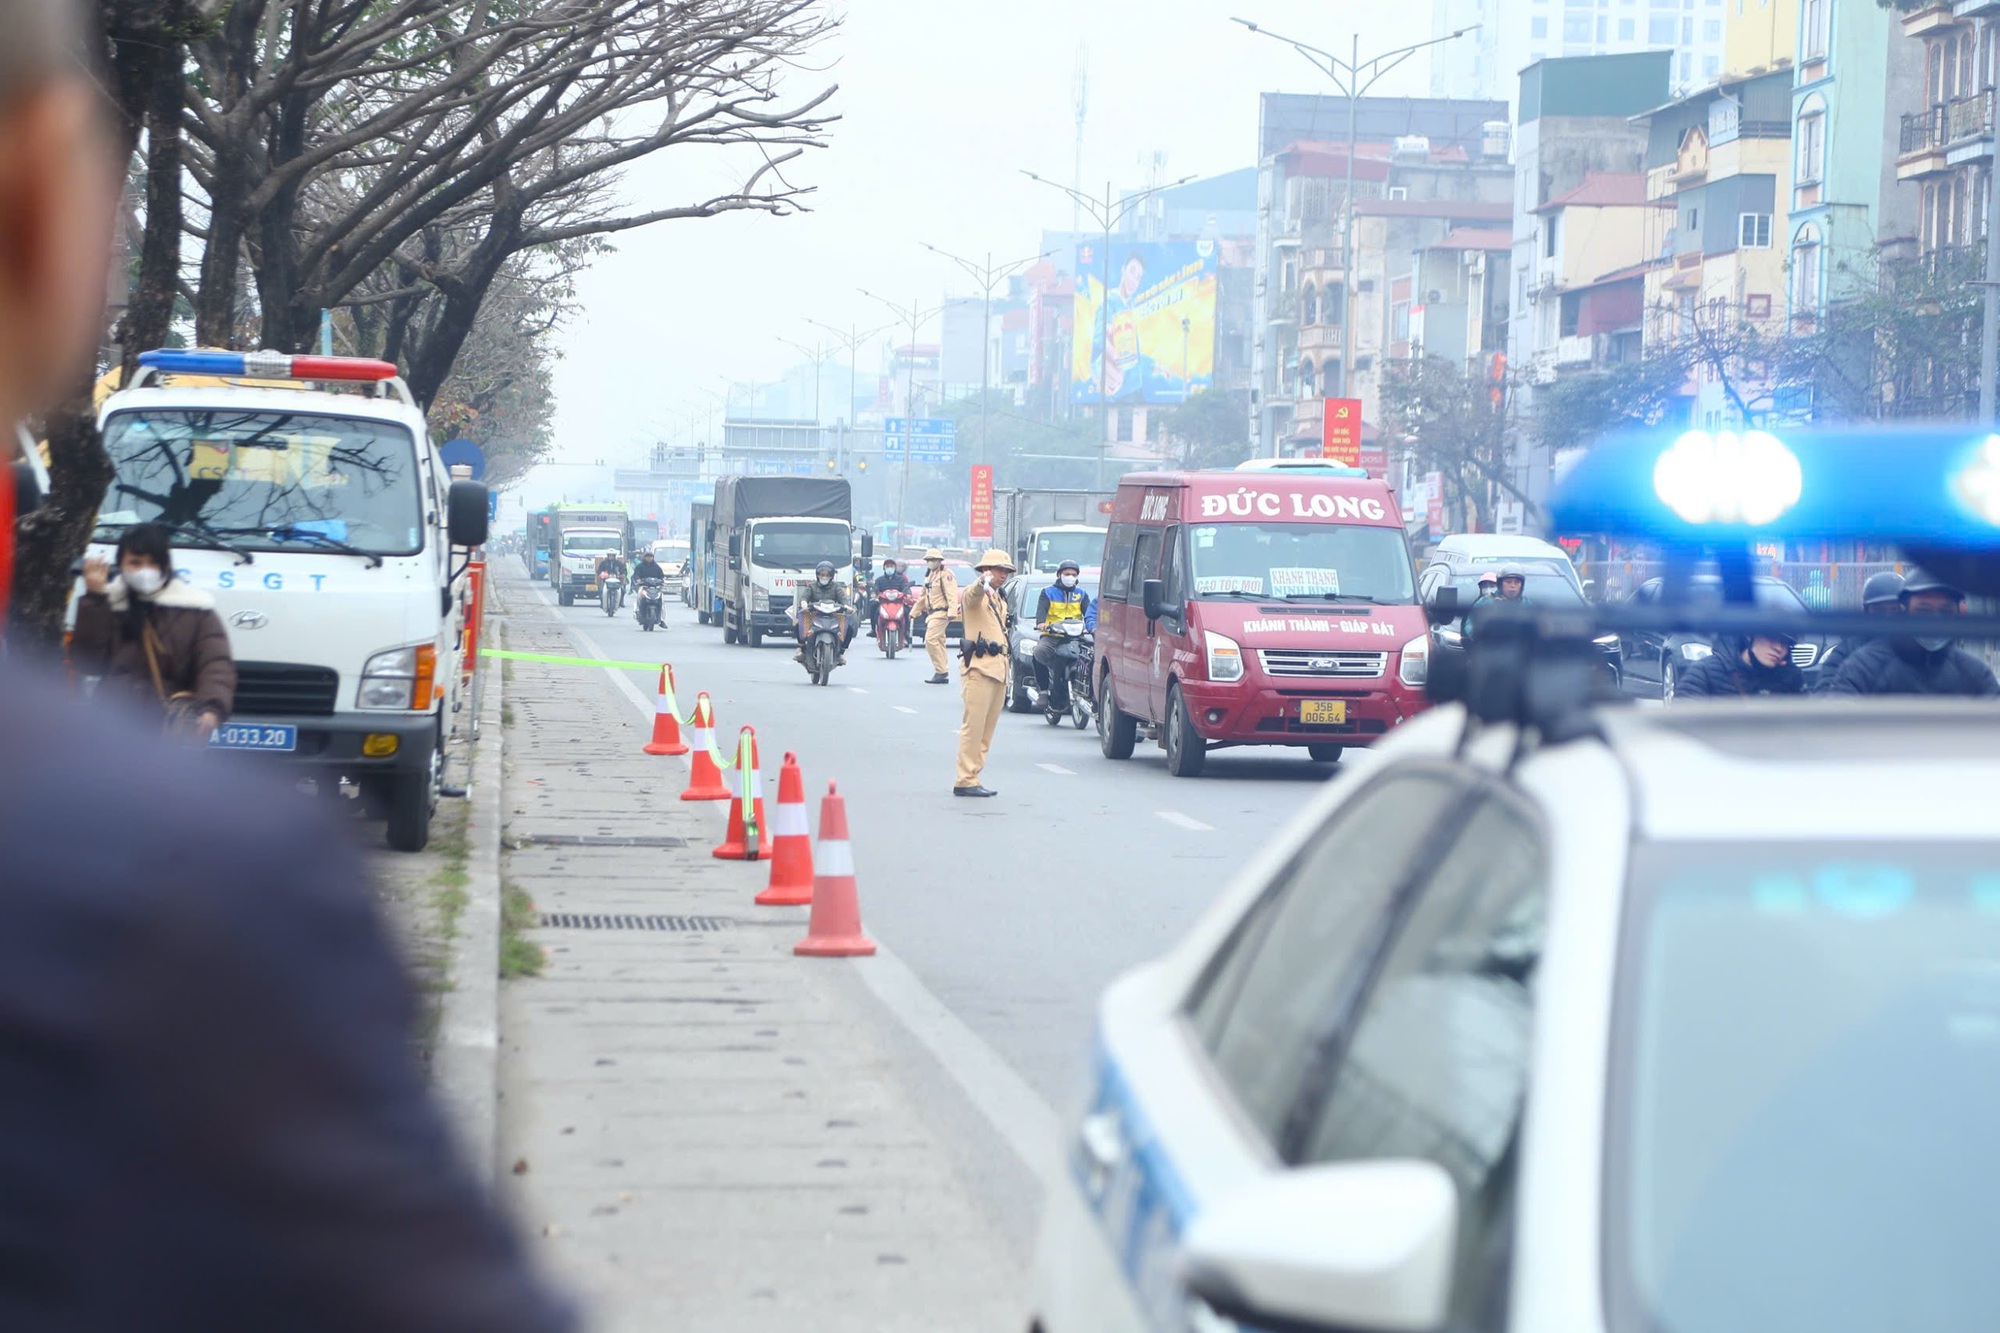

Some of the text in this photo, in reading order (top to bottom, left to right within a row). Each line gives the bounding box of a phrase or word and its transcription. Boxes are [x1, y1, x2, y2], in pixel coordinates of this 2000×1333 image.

[1201, 487, 1385, 521] ĐỨC LONG
[1197, 580, 1217, 591] CAO
[1243, 619, 1286, 633] KHÁNH
[1340, 619, 1369, 633] GIÁP
[1372, 621, 1396, 636] BÁT
[1314, 702, 1333, 712] 35B
[1305, 712, 1340, 722] 006.64
